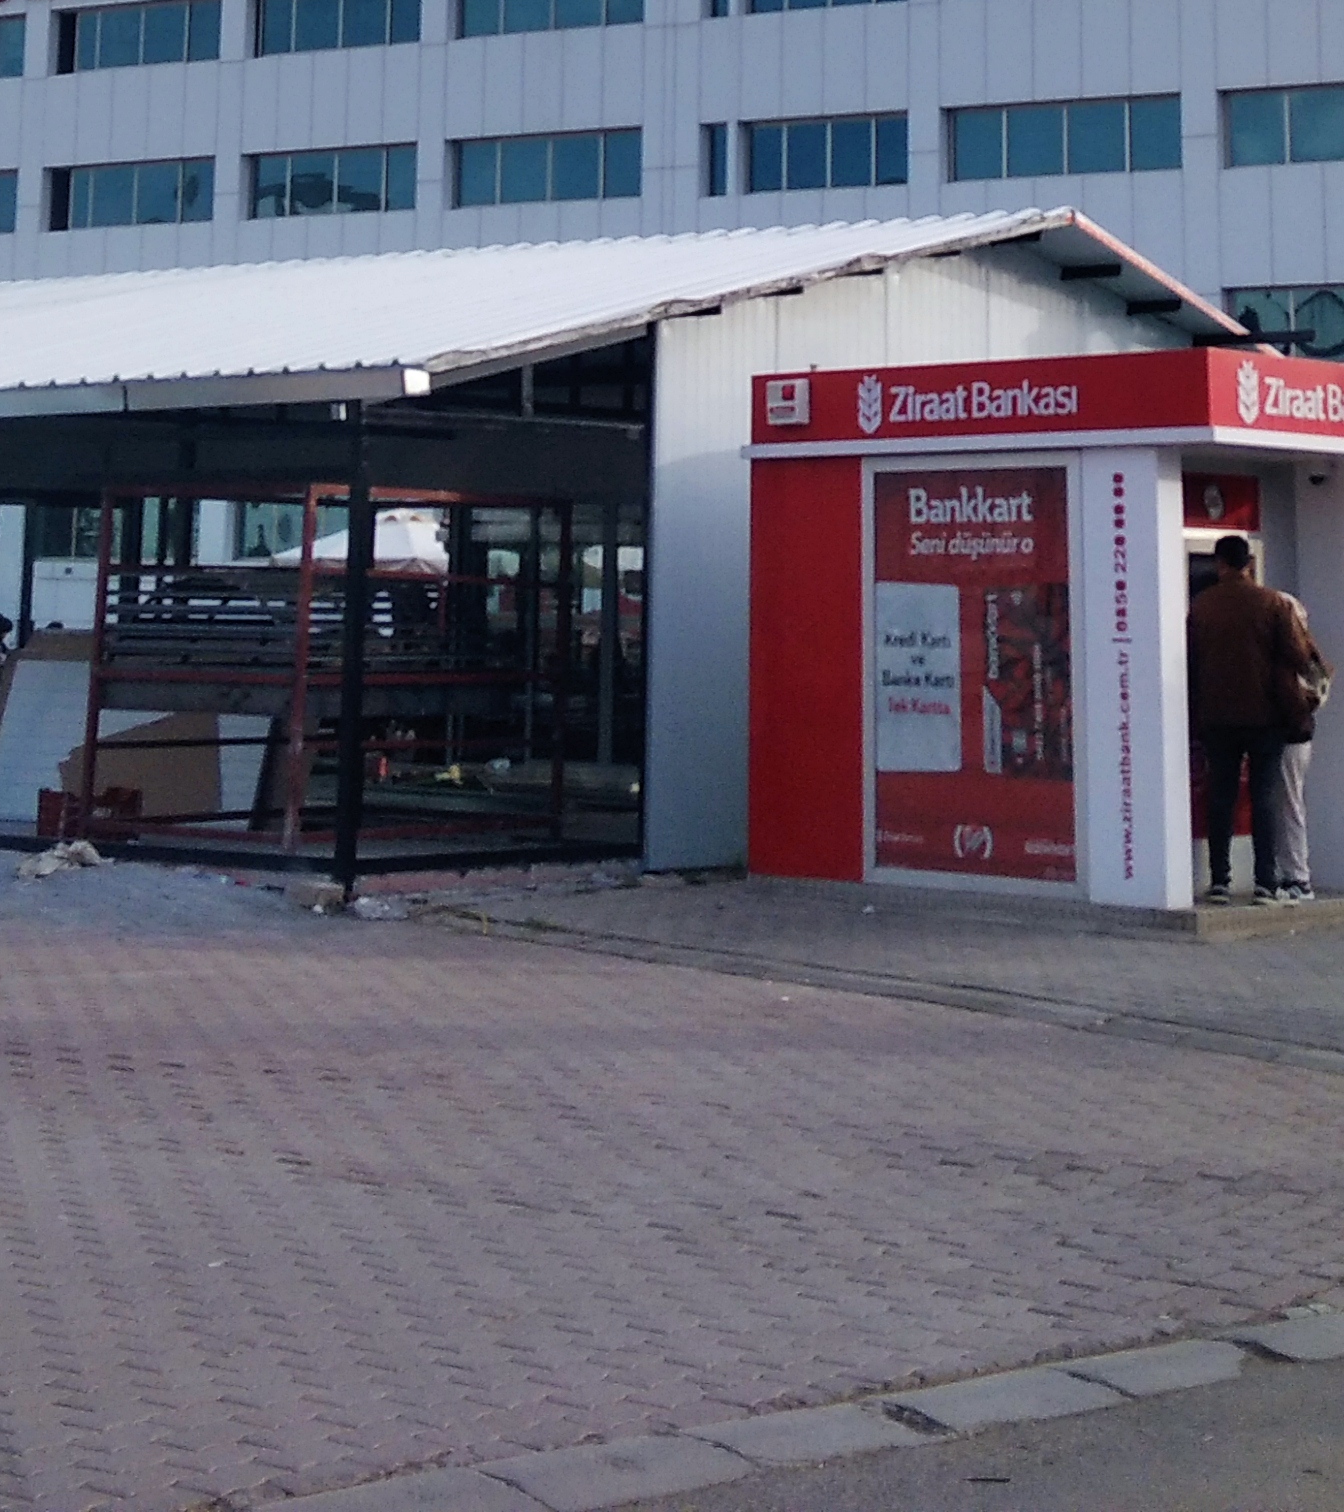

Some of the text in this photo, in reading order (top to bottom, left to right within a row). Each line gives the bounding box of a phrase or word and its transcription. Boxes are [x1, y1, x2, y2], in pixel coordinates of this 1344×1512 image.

[889, 379, 1078, 424] Ziraat Bankası
[1263, 376, 1326, 419] Ziraat
[908, 485, 1034, 525] Bankkart
[910, 531, 946, 556] Seni
[1118, 649, 1134, 881] www.ziraatbank.com.tr
